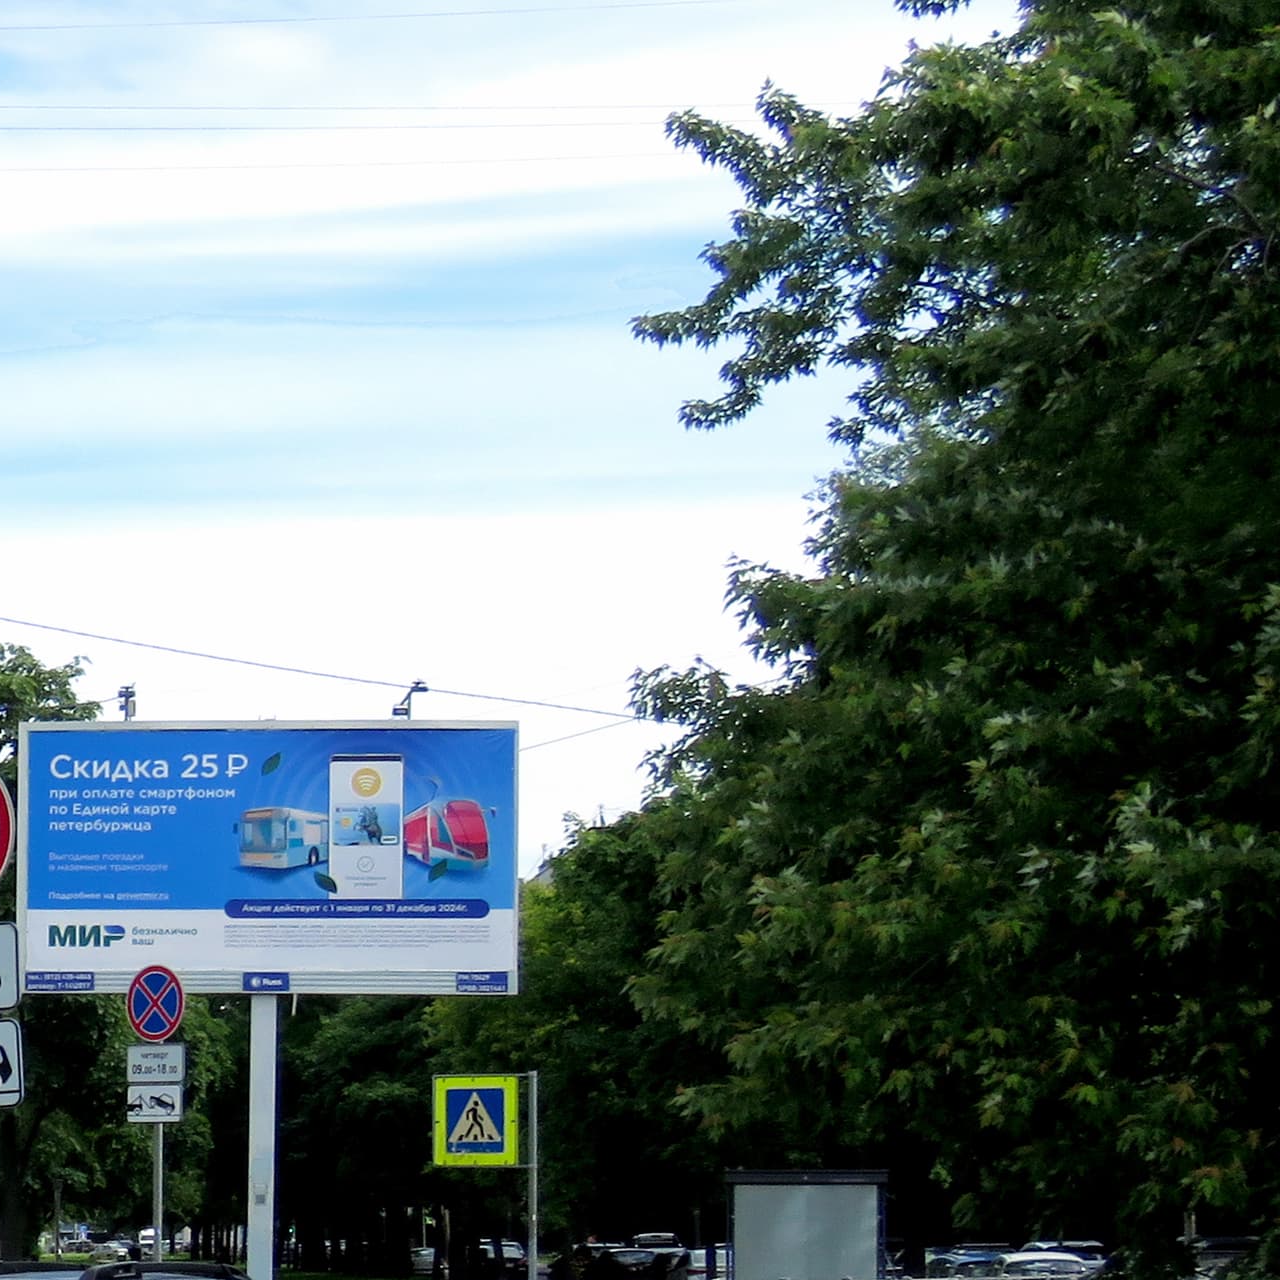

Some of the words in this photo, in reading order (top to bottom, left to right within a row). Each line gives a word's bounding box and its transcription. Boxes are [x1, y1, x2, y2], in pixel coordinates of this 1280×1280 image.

[50, 754, 169, 782] Скидка
[180, 754, 218, 778] 25
[49, 788, 78, 800] при
[82, 788, 134, 799] оплате
[139, 786, 236, 800] смартфоном
[49, 804, 68, 815] по
[72, 802, 129, 816] Единой
[133, 804, 177, 816] карте
[49, 820, 152, 833] петербуржца
[48, 925, 126, 947] МИР
[132, 926, 197, 936] безналично
[132, 938, 154, 946] ваш
